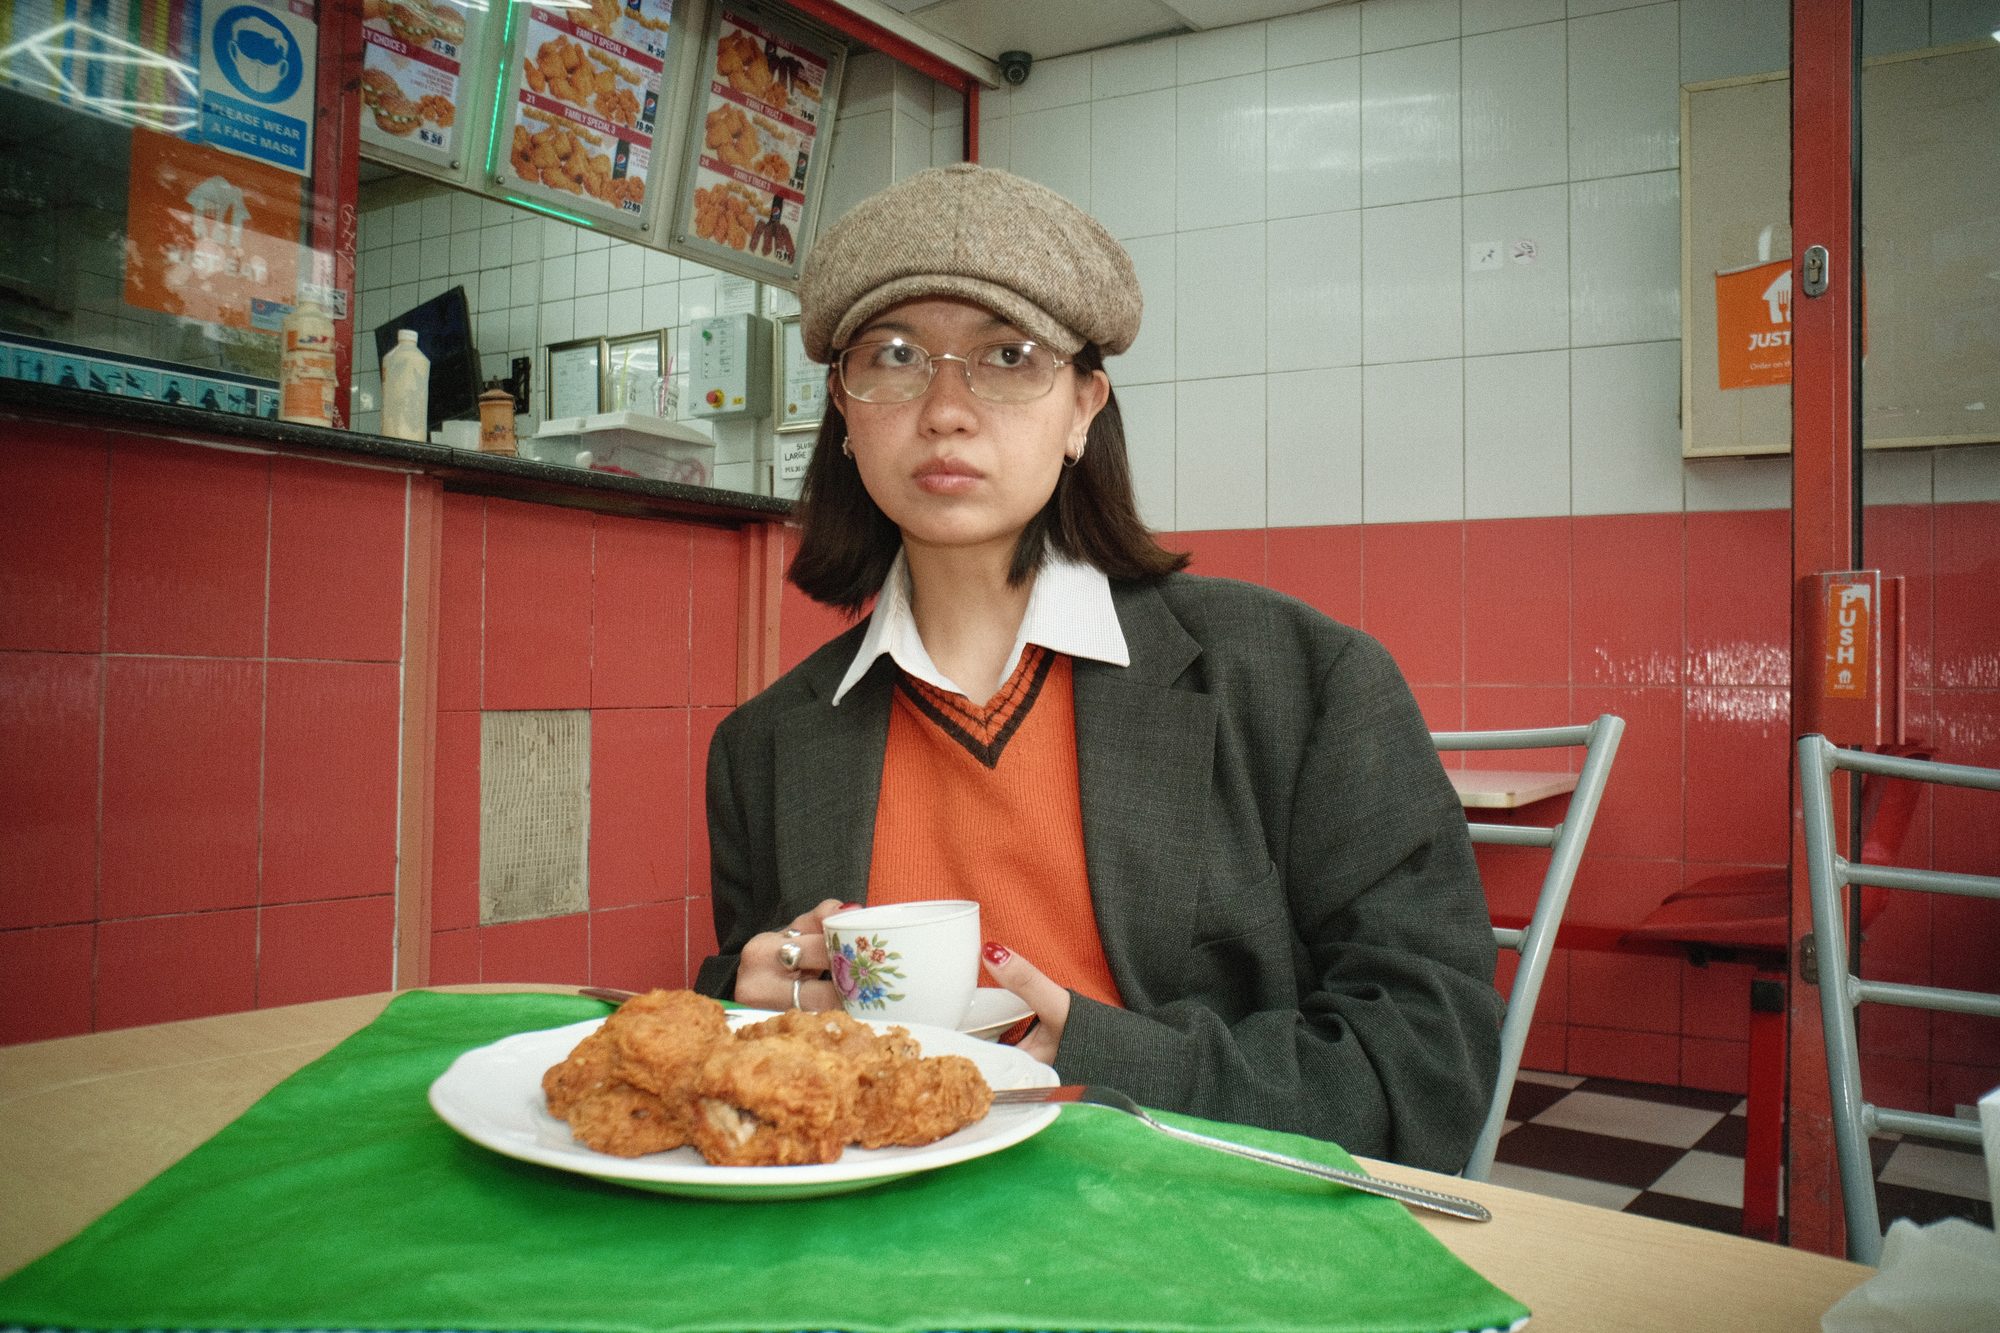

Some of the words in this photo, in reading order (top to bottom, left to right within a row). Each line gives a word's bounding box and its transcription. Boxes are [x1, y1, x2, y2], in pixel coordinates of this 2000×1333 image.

[574, 26, 599, 45] FAMILY
[597, 35, 623, 55] SPECIAL
[525, 93, 536, 104] 21
[211, 102, 261, 127] PLEASE
[263, 120, 300, 140] WEAR
[564, 107, 586, 123] FAMILY
[586, 115, 612, 133] SPECIAL
[212, 122, 222, 134] A
[224, 125, 257, 145] FACE
[260, 137, 298, 157] MASK
[1748, 331, 1792, 352] JUST
[784, 451, 807, 461] LARGE
[1837, 588, 1857, 665] PUSH
